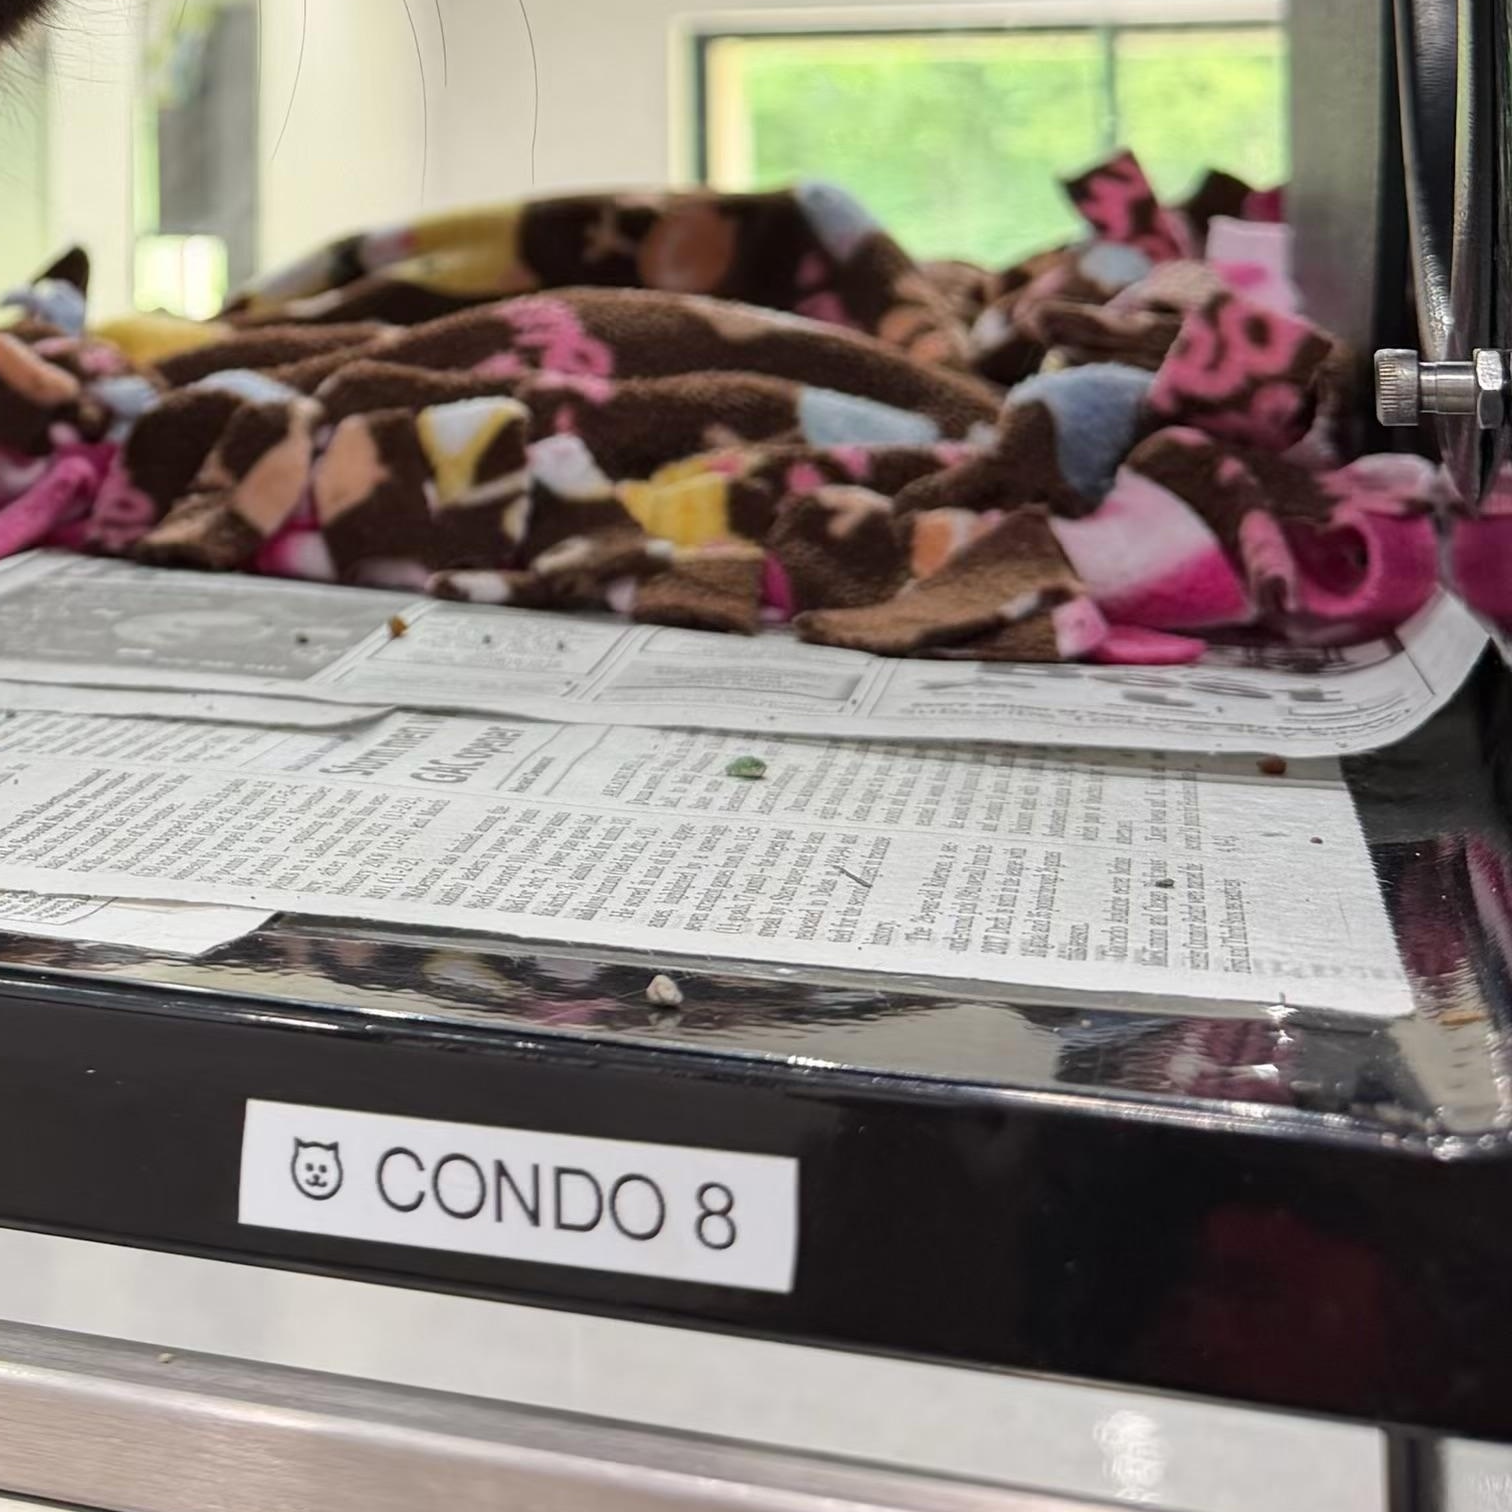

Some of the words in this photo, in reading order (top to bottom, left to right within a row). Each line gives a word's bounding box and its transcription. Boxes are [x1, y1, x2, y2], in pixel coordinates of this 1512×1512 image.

[409, 758, 486, 784] GAC
[454, 726, 527, 761] opener
[376, 1146, 666, 1242] CONDO
[695, 1181, 737, 1251] 8
